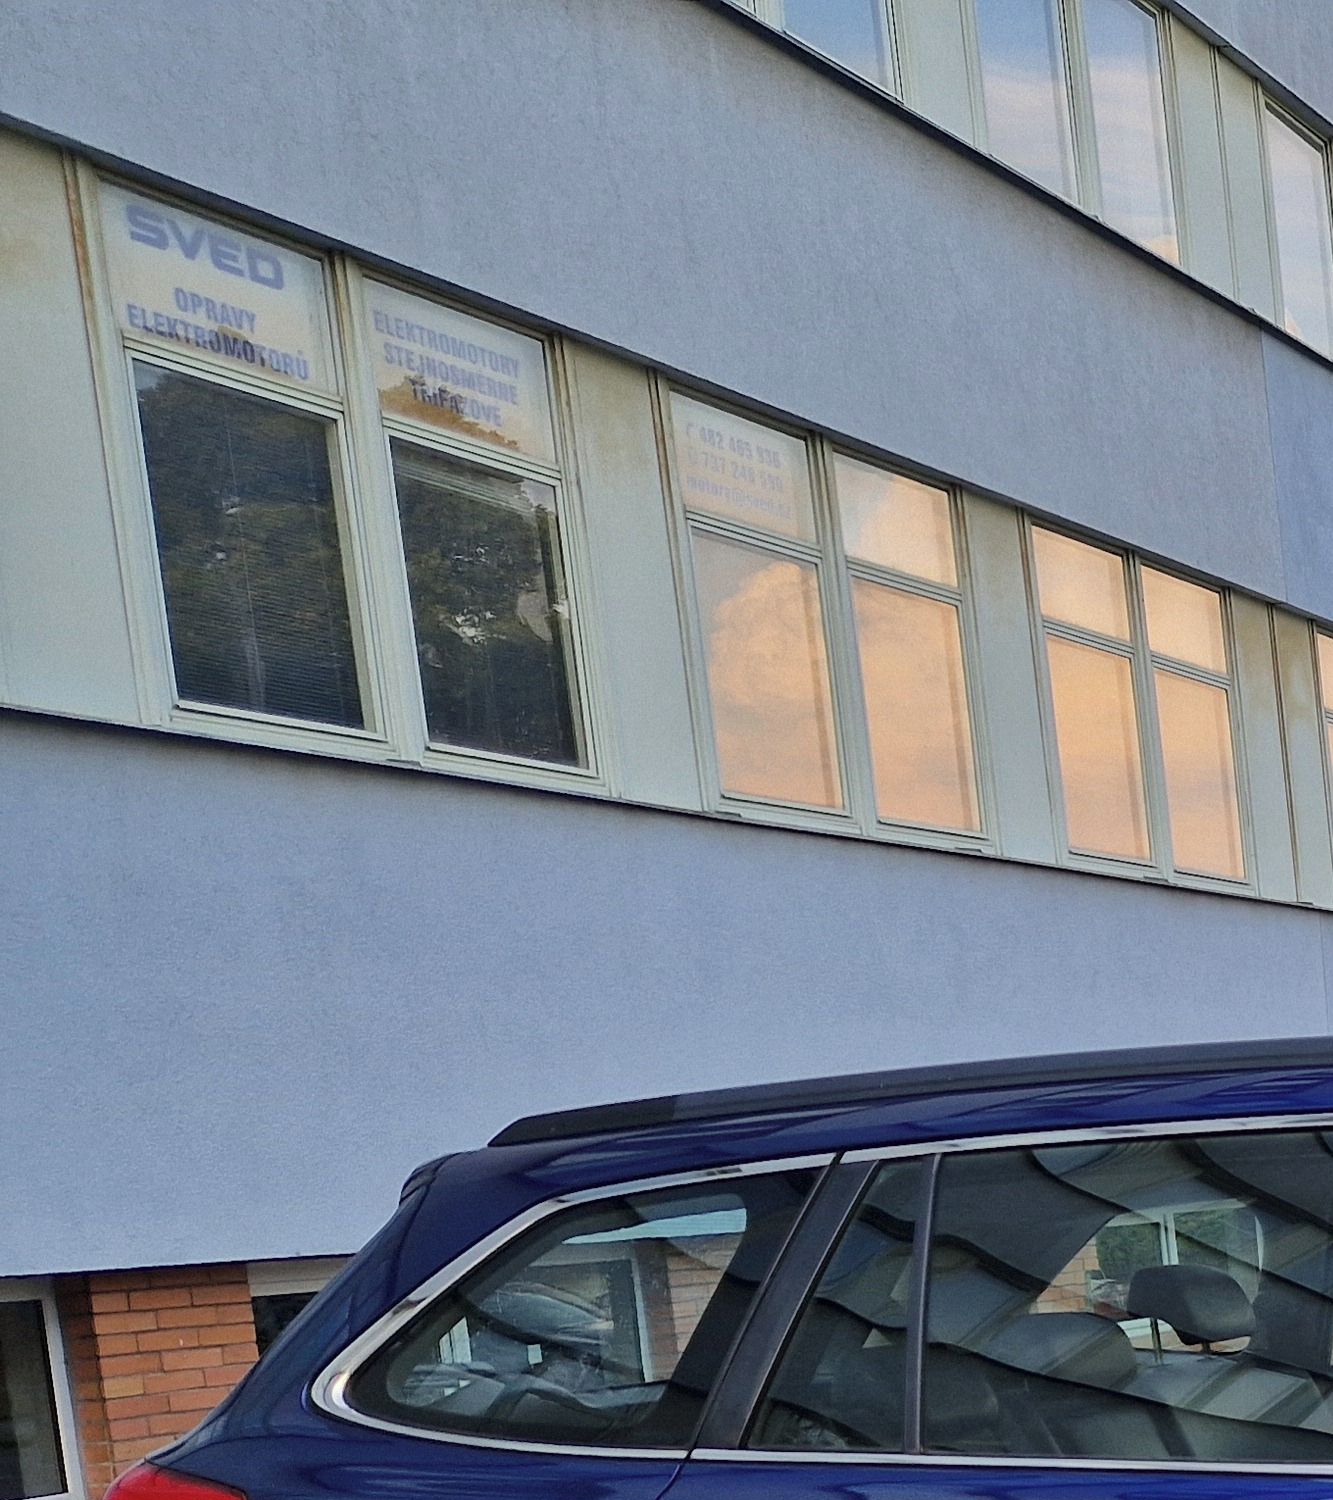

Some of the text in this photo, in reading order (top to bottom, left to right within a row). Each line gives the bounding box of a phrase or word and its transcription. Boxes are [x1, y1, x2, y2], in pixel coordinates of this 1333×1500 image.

[126, 205, 284, 290] SVED
[174, 287, 256, 334] OPRAVY
[373, 309, 519, 379] ELEKTROMOTORY
